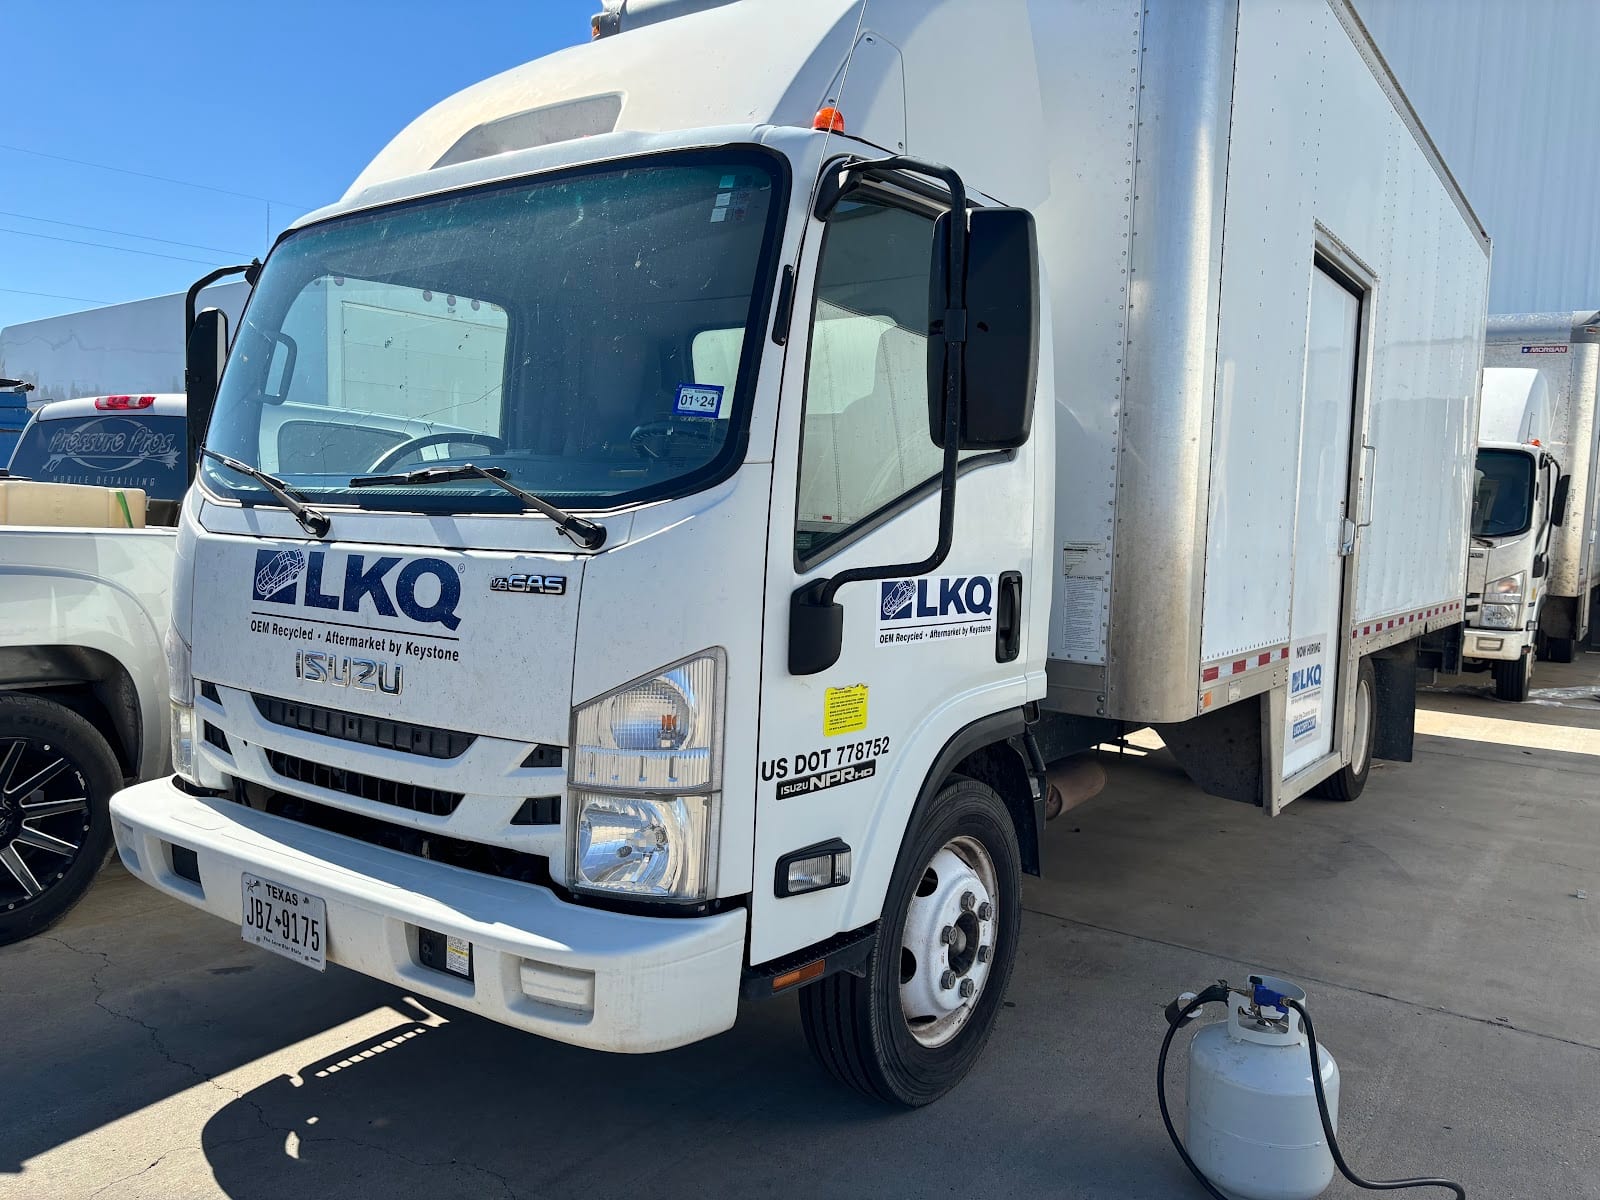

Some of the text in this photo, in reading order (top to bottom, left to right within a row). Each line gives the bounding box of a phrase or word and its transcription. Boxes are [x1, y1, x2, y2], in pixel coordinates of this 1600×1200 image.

[96, 475, 156, 487] DETAILING
[304, 551, 462, 631] LKQ
[917, 576, 992, 617] LKQ
[250, 619, 460, 662] OEM Recycled Aftermarket by Keystone
[879, 624, 992, 644] OEM Recycled Aftermarket by Keystone
[295, 648, 404, 697] ISUZU
[1300, 664, 1322, 690] LKQ
[761, 736, 890, 781] US DOT 778752
[780, 781, 809, 795] ISUZU
[809, 767, 856, 791] NPR
[266, 883, 298, 906] TEXAS
